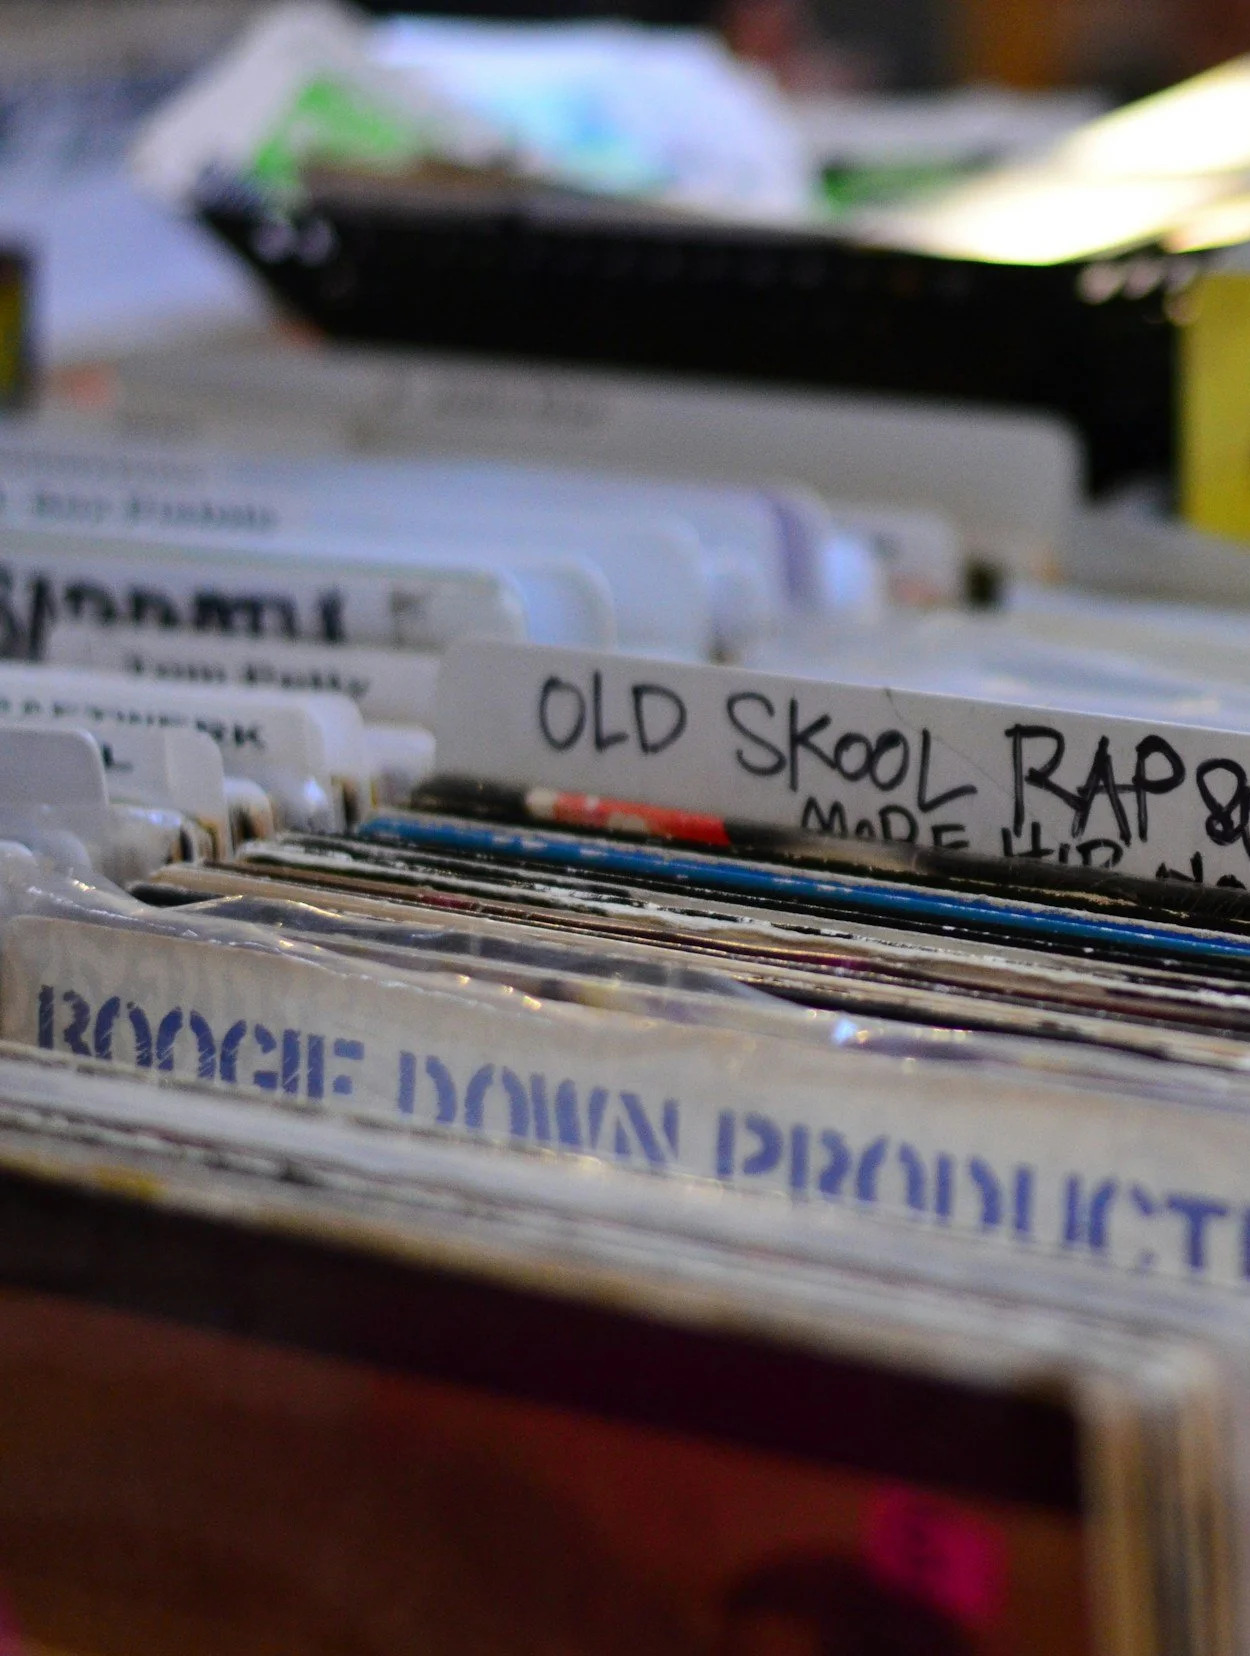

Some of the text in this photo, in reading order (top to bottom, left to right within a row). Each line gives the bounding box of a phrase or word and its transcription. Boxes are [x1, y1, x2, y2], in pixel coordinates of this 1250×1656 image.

[538, 668, 688, 755] OLD
[725, 690, 978, 814] SKOOL
[1004, 722, 1188, 846] RAP
[36, 984, 366, 1100] BOOGIE
[398, 1050, 682, 1168] DOWN
